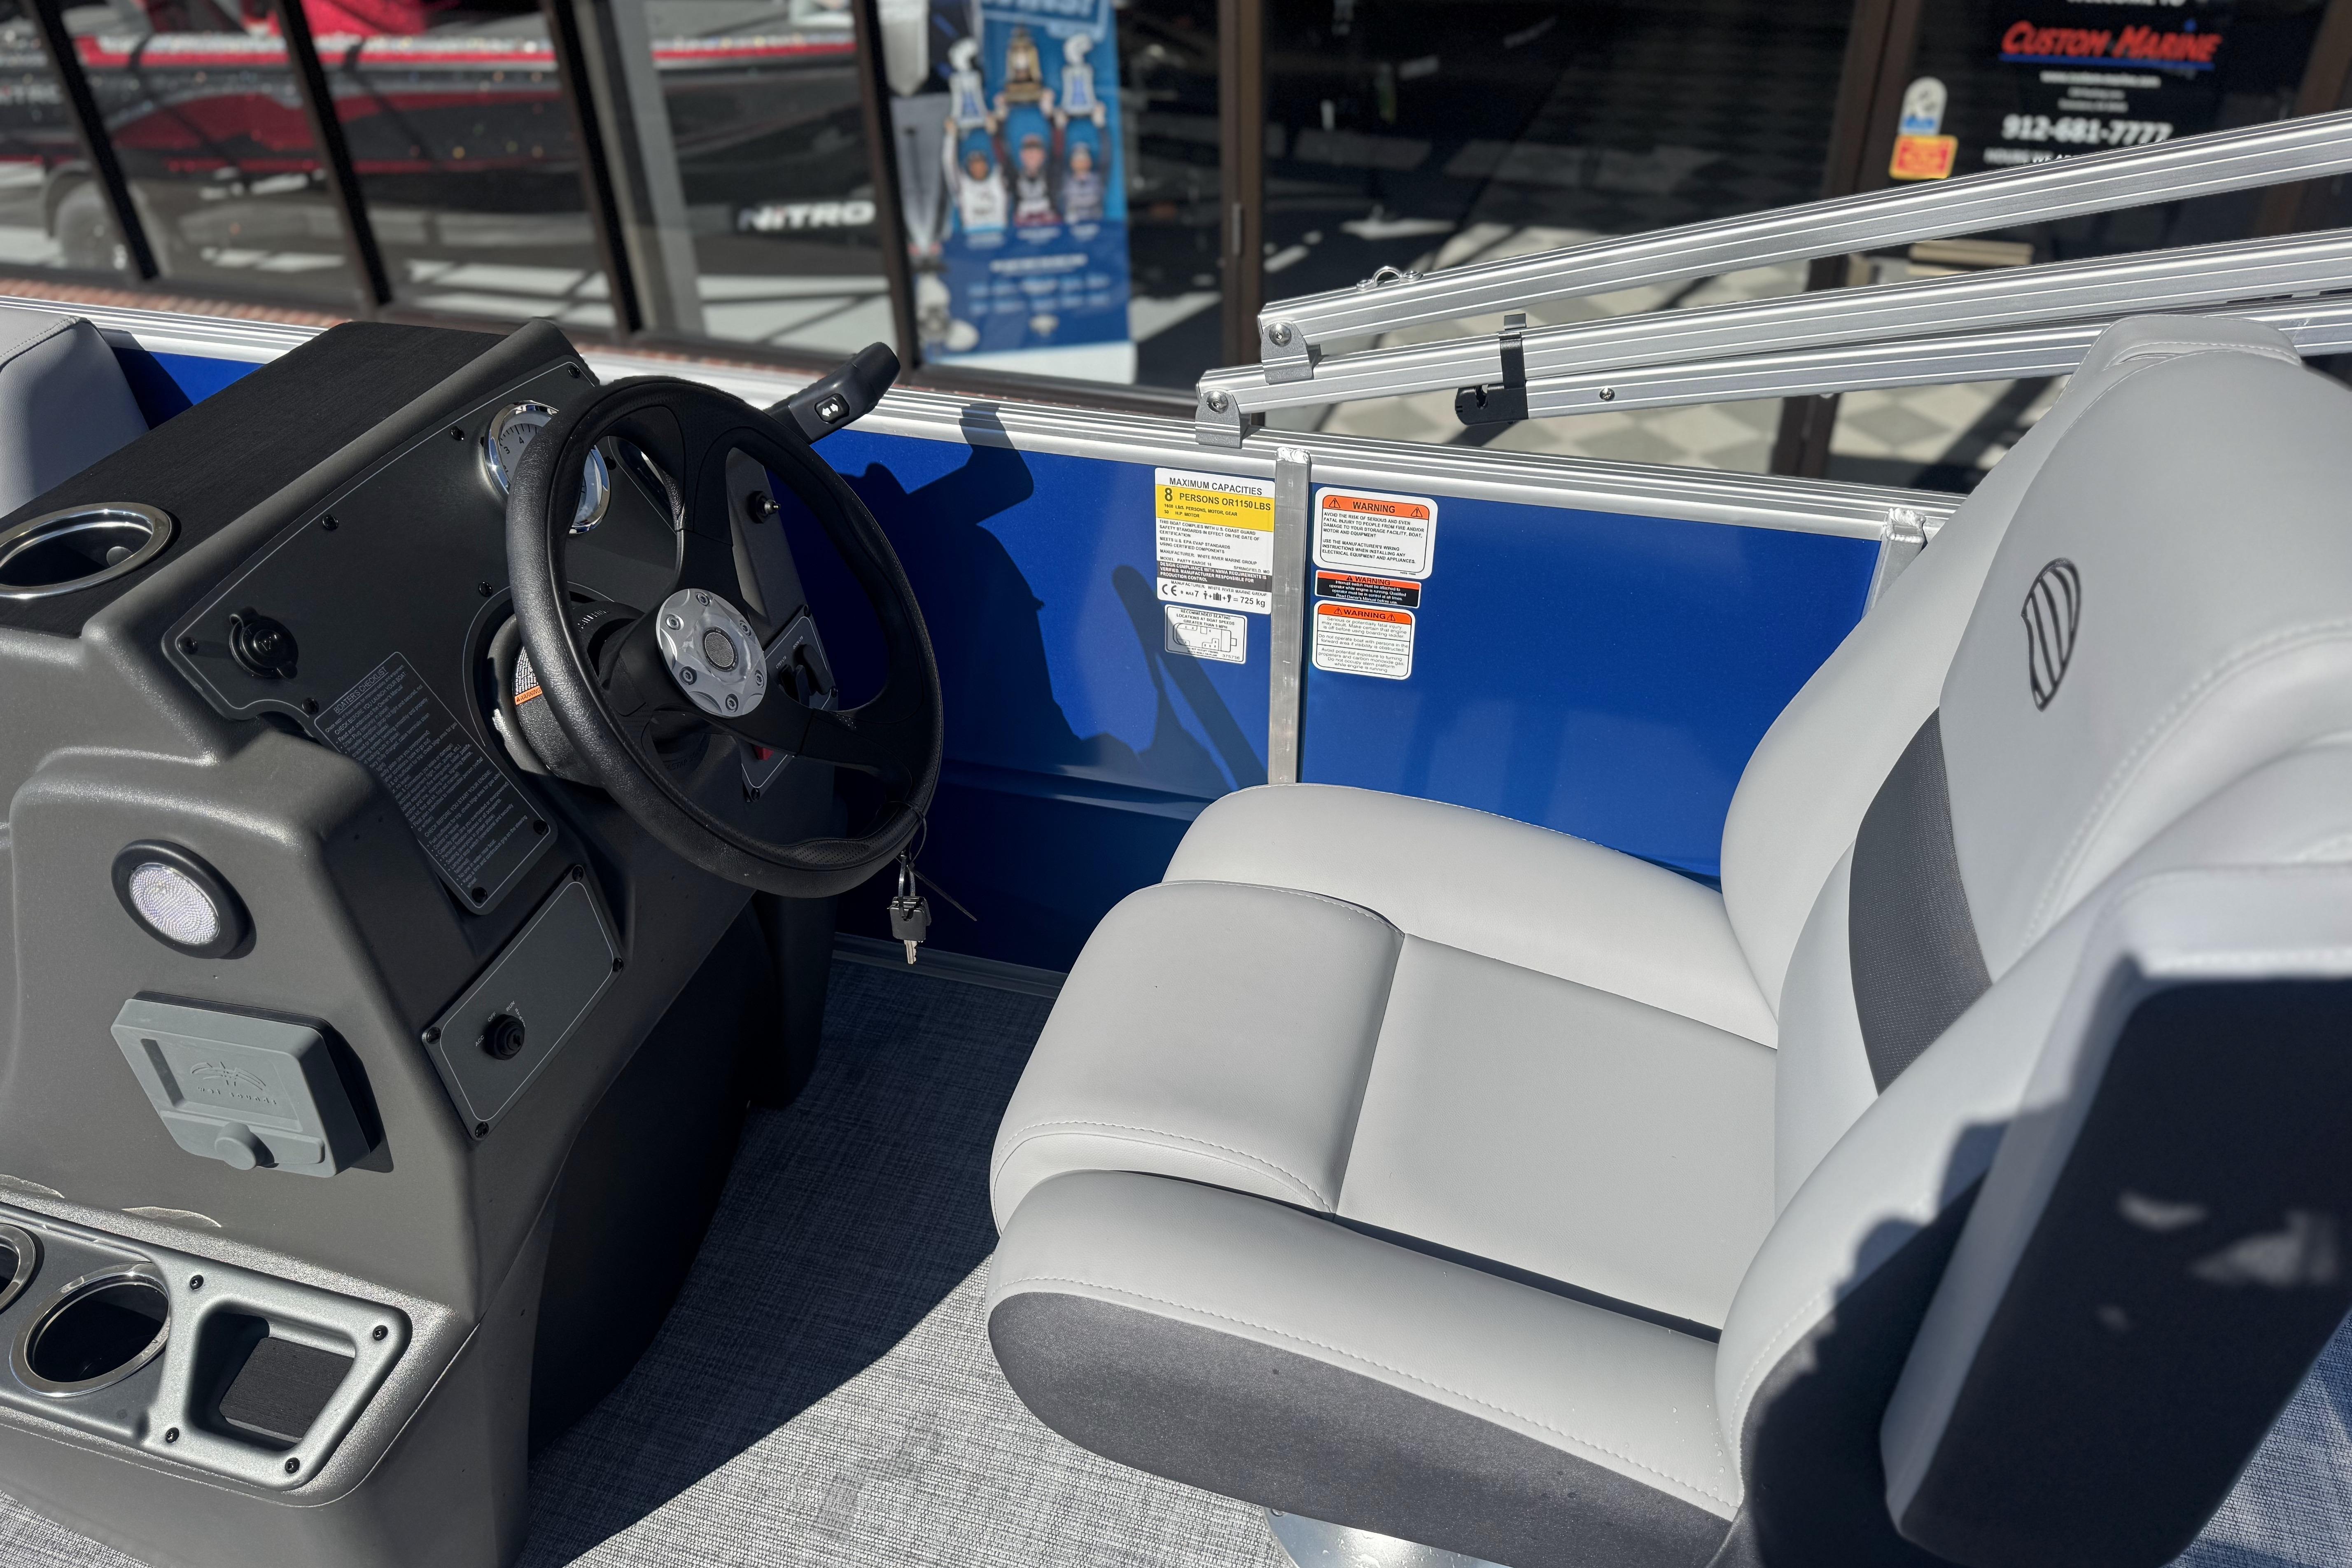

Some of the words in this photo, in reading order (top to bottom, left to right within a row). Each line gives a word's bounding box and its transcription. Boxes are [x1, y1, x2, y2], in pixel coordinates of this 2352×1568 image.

[2002, 20, 2112, 57] CUSTOM
[2112, 25, 2223, 63] MARINE
[2002, 114, 2173, 147] 912-681-7777
[739, 201, 876, 231] NITRO
[1169, 477, 1209, 489] MAXIMUM
[1212, 482, 1262, 495] CAPACITIES
[1164, 487, 1172, 502] 8
[1179, 492, 1219, 505] PERSONS
[1254, 501, 1270, 511] LBS
[1352, 501, 1395, 513] WARNING
[1354, 576, 1391, 586] WARNING
[1240, 596, 1253, 604] 725
[1256, 598, 1265, 608] kg
[1343, 609, 1386, 619] WARNING
[333, 689, 361, 714] BOATER'S
[358, 666, 388, 693] CHECKLIST
[520, 687, 541, 700] WARNING
[334, 721, 350, 735] CHECK
[347, 708, 364, 724] BEFORE
[363, 701, 373, 711] YOU
[371, 688, 387, 704] LAUNCH
[385, 680, 398, 691] YOUR
[423, 822, 438, 838] CHECK
[435, 809, 452, 826] BEFORE
[449, 801, 460, 812] YOU
[457, 791, 470, 804] START
[467, 781, 479, 793] YOUR
[506, 1000, 515, 1011] RUN
[488, 1011, 496, 1022] OFF
[476, 1035, 484, 1047] ACC
